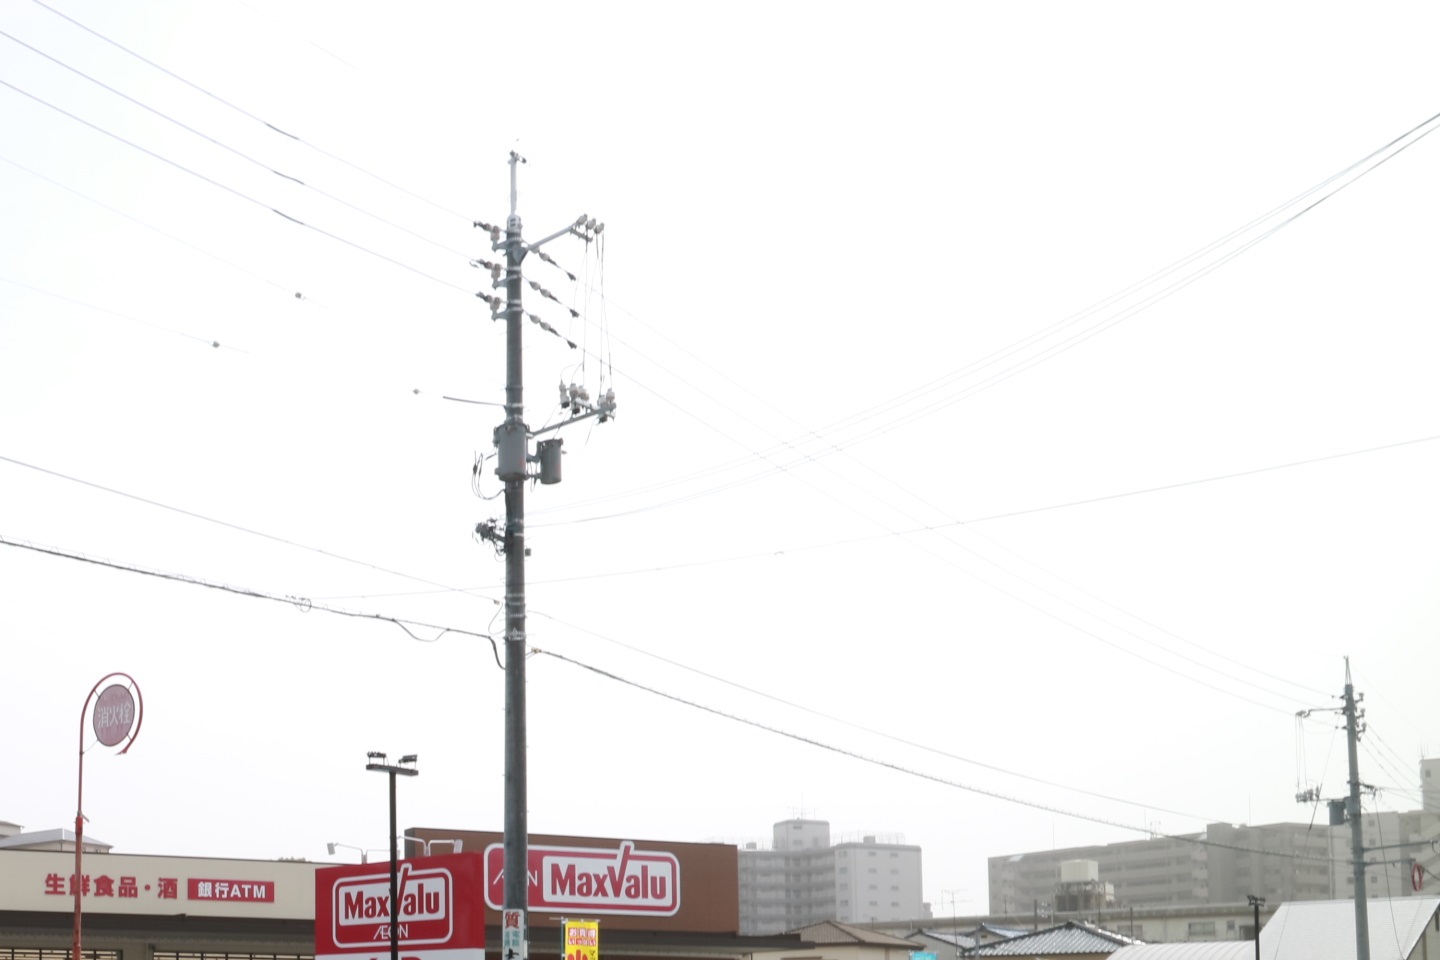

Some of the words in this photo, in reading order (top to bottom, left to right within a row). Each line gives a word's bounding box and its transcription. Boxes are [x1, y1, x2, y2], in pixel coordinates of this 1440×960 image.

[97, 701, 131, 729] 消火栓
[197, 881, 266, 899] 銀行ATM
[550, 845, 667, 900] MaxValu
[344, 867, 440, 920] MaxValu
